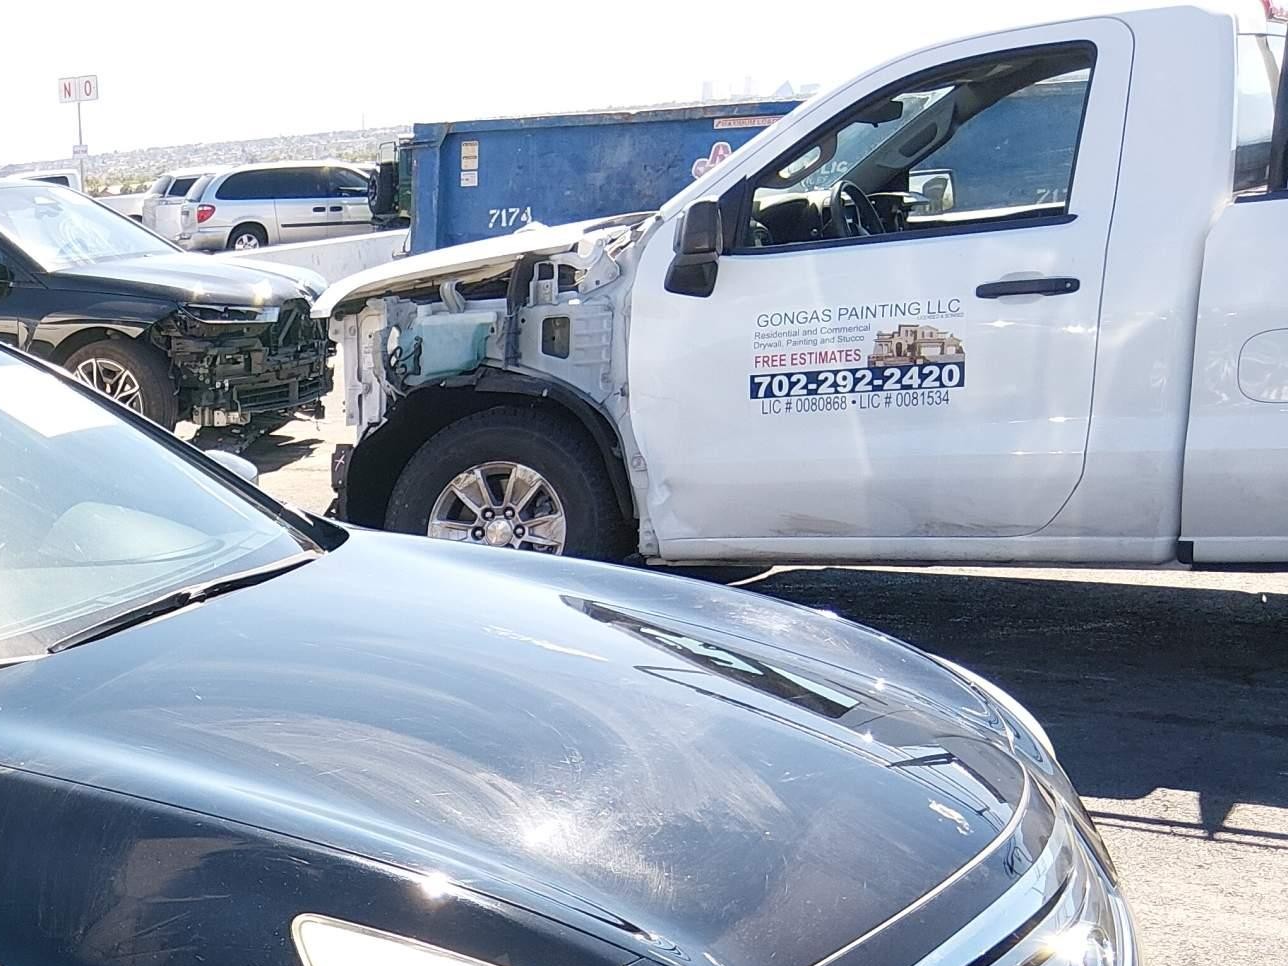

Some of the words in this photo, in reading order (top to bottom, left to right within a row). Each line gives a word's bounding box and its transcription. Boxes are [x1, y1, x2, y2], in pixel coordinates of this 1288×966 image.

[63, 82, 72, 99] N
[488, 206, 532, 229] 7174
[756, 308, 832, 328] GONGAS
[838, 302, 921, 321] PAINTING
[927, 299, 961, 315] LLC
[754, 328, 800, 340] Residential
[802, 328, 818, 336] and
[786, 338, 818, 347] Painting
[819, 336, 835, 345] and
[837, 335, 865, 343] Stucco
[754, 353, 787, 368] FREE
[791, 349, 862, 366] ESTIMATES
[754, 364, 961, 398] 702-292-2420
[761, 399, 781, 415] LIC
[785, 399, 792, 413] #
[796, 396, 847, 413] 0080868
[859, 393, 881, 409] LIC
[884, 392, 892, 408] #
[895, 390, 950, 408] 0081534
